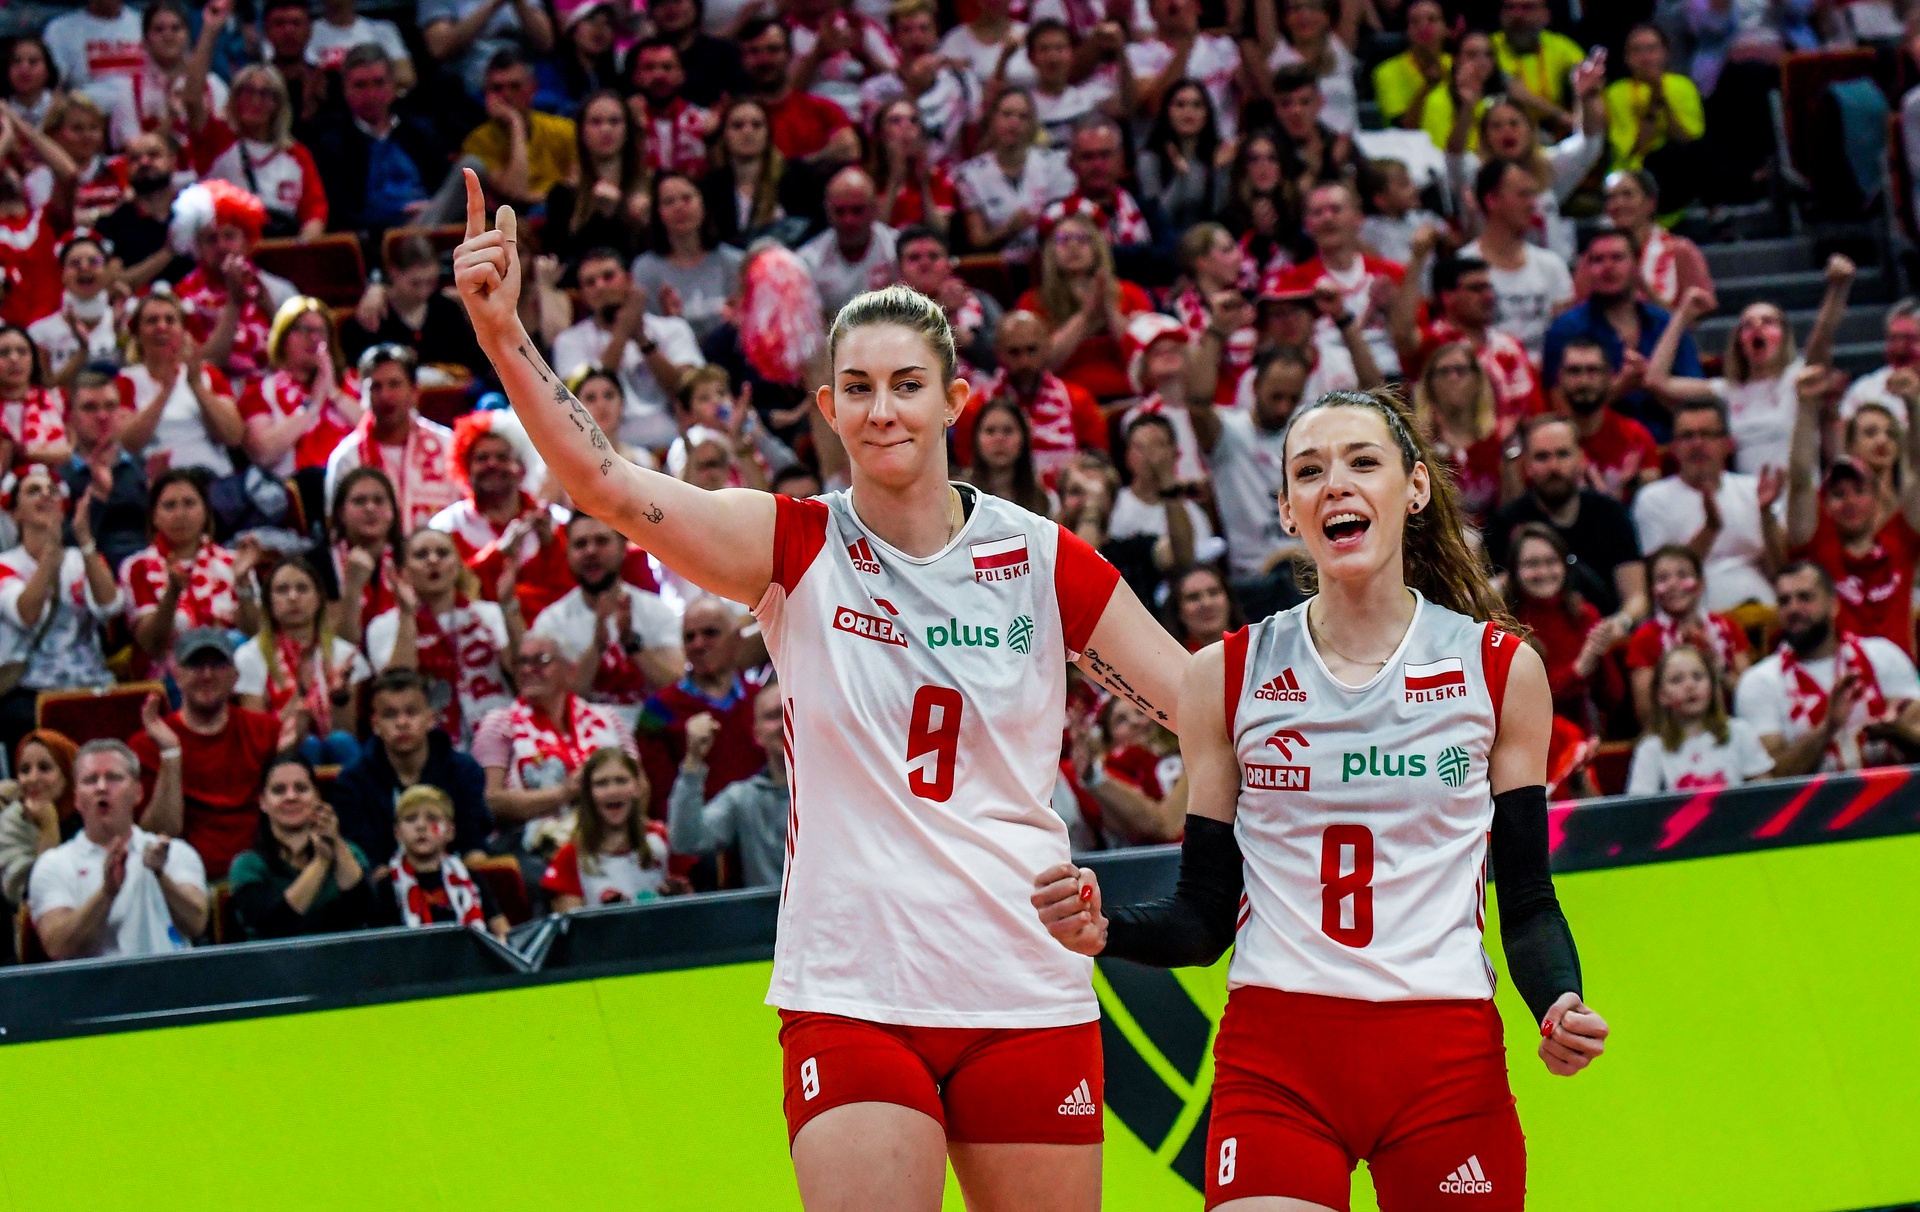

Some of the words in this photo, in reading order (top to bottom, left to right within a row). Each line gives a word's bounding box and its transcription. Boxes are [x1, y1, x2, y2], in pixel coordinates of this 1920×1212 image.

[975, 563, 1030, 583] POLSKA
[838, 611, 905, 644] ORLEN
[926, 617, 1000, 650] plus
[1084, 648, 1115, 672] Don't
[1254, 689, 1307, 702] adidas
[1405, 685, 1467, 703] POLSKA
[906, 684, 964, 803] 9
[1247, 766, 1305, 788] ORLEN
[1341, 745, 1427, 783] plus
[1320, 824, 1374, 949] 8
[800, 1056, 820, 1101] 9
[1057, 1100, 1096, 1116] adidas
[1218, 1137, 1238, 1187] 8
[1439, 1178, 1493, 1195] adidas
